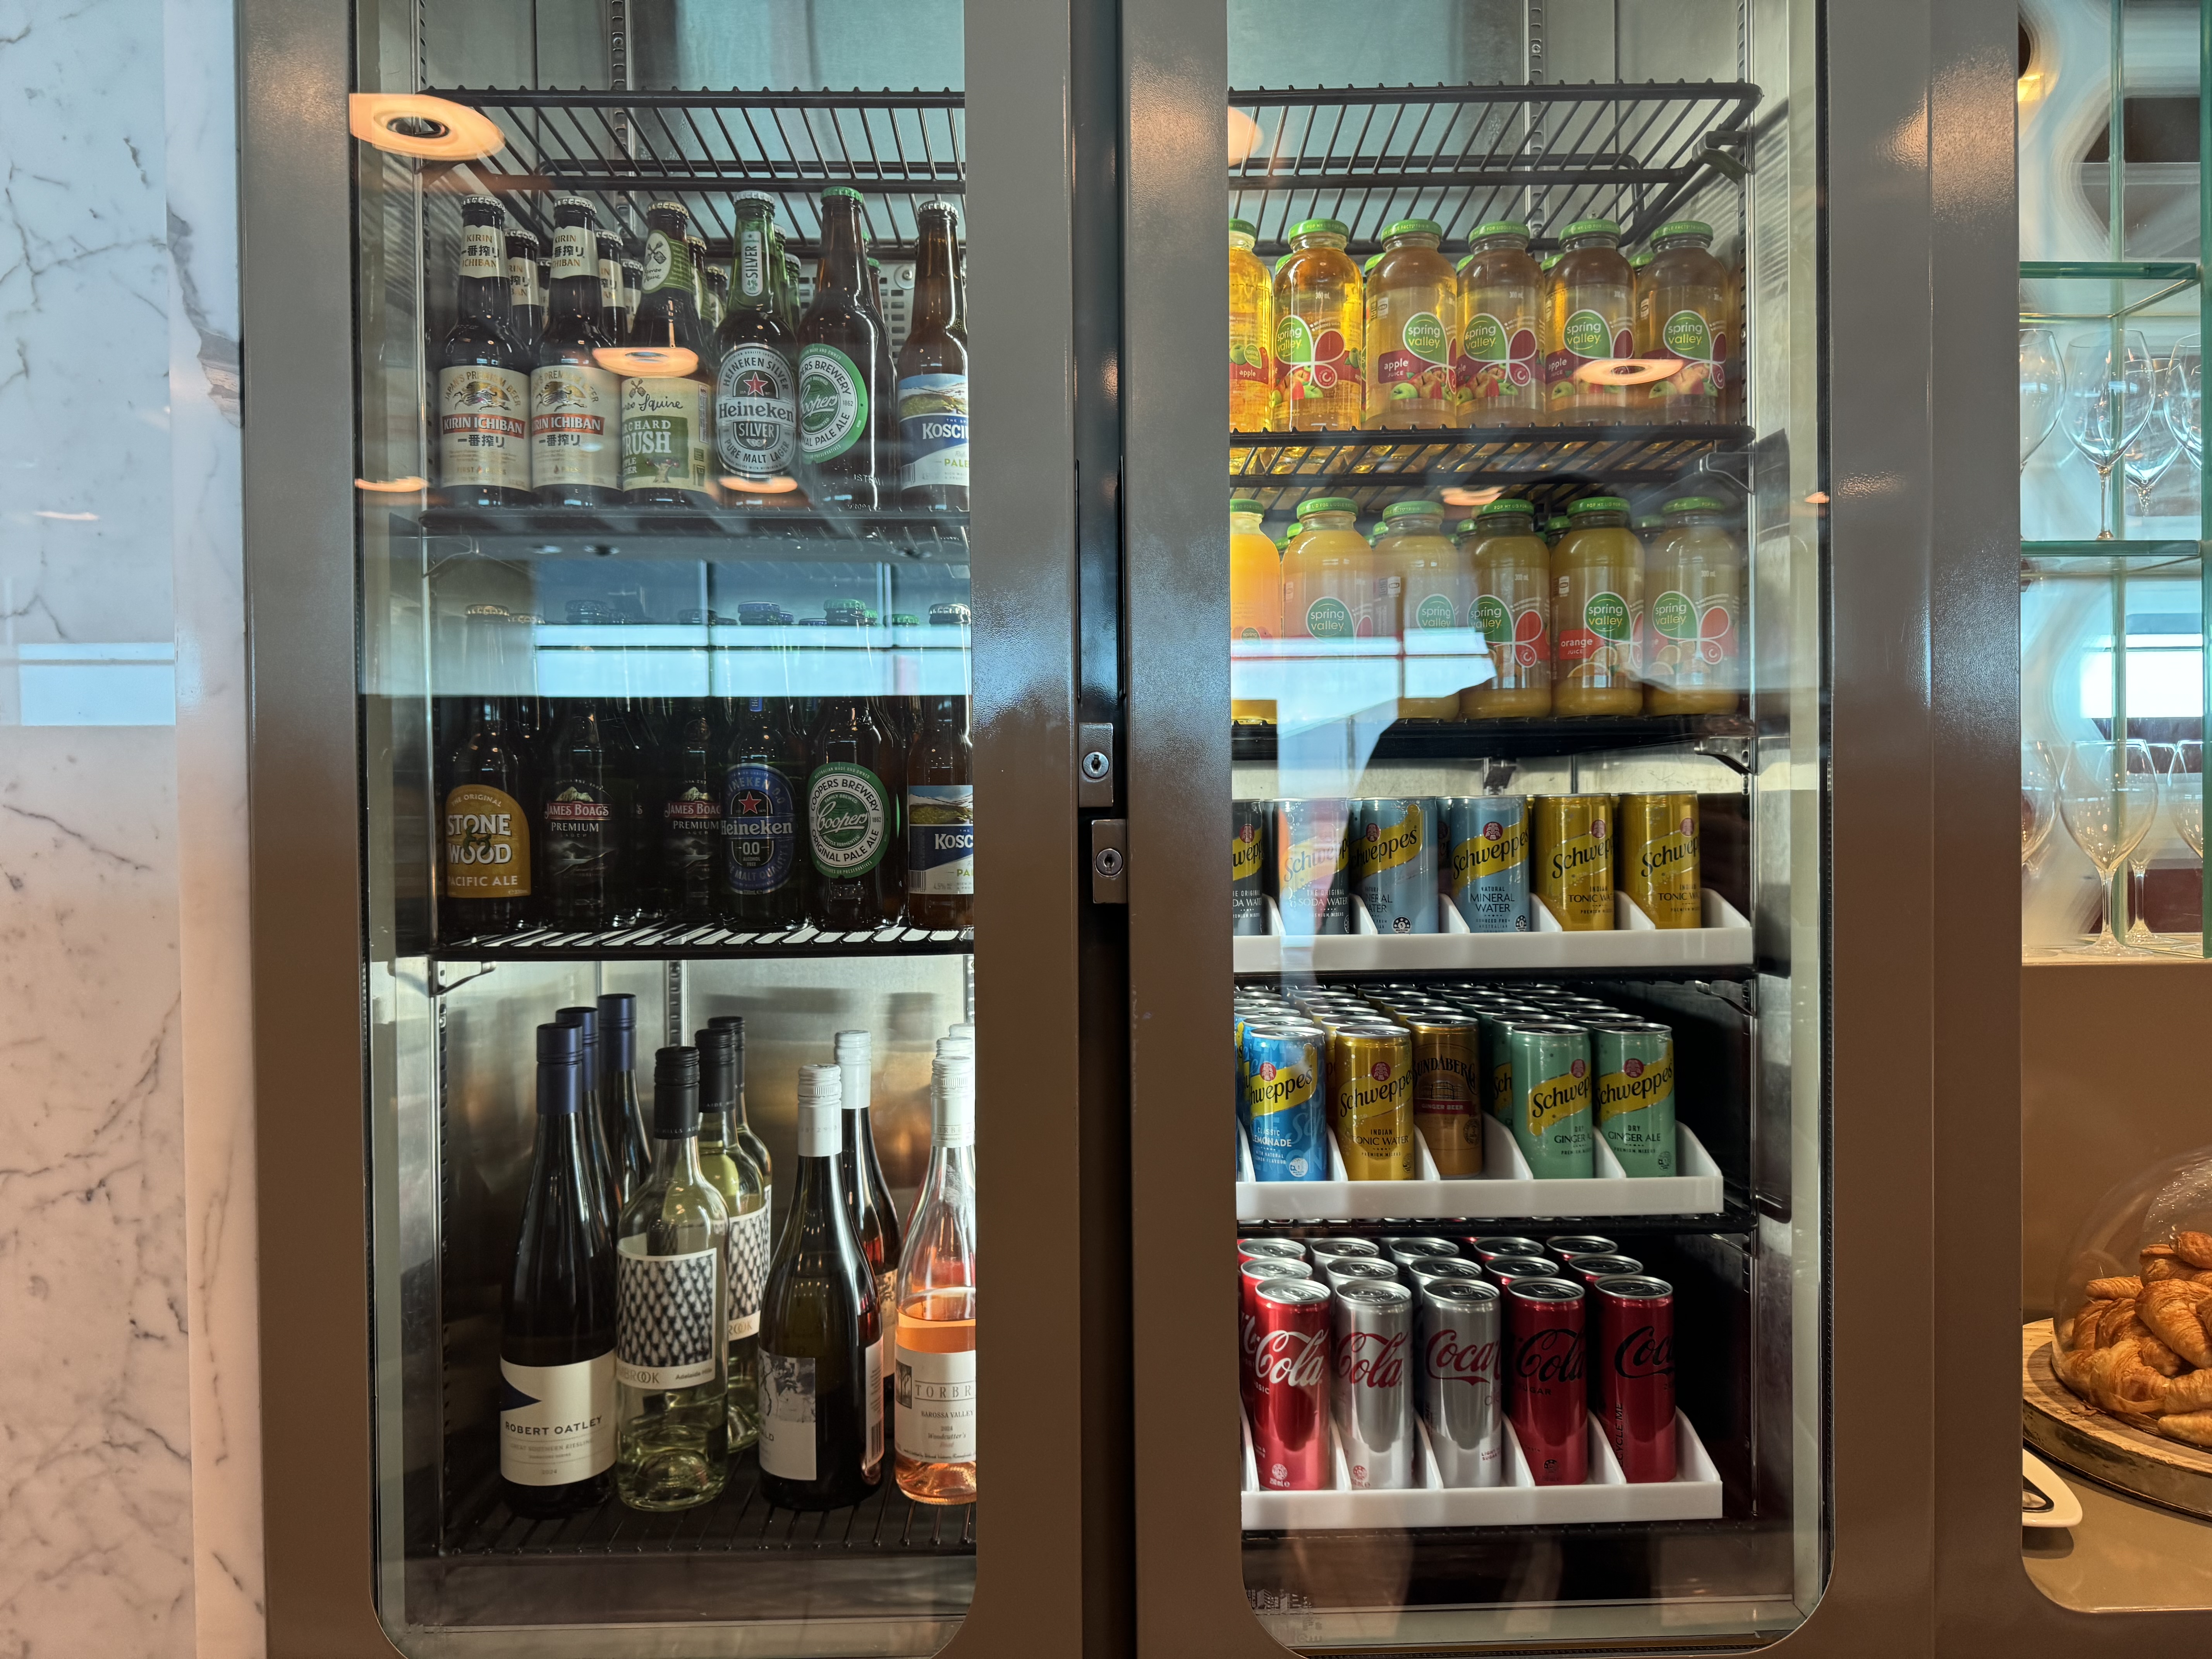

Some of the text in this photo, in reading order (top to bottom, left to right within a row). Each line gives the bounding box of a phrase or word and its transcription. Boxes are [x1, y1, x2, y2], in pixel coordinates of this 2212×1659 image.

[466, 234, 493, 244] KIRIN
[461, 246, 500, 258] 一番搾り
[554, 246, 585, 258] 番搾り
[462, 259, 496, 268] ICHIBAN
[745, 246, 757, 279] SILVER
[1277, 325, 1302, 343] spring
[1408, 325, 1440, 340] spring
[1465, 321, 1496, 340] spring
[1566, 321, 1601, 336] spring
[1668, 322, 1702, 335] spring
[1277, 338, 1302, 352] valley
[1408, 338, 1440, 347] valley
[1465, 336, 1496, 350] valley
[1567, 334, 1601, 345] valley
[1668, 334, 1702, 345] valley
[1384, 359, 1409, 371] apple
[723, 357, 789, 391] HEINEKEN SILVER
[814, 360, 852, 396] BREWERY
[1239, 369, 1256, 378] apple
[507, 383, 521, 407] BEER
[639, 394, 683, 412] Squire
[718, 401, 794, 423] Heineken
[443, 417, 522, 434] KIRIN ICHIBAN
[551, 417, 601, 431] ICHIBAN
[623, 420, 672, 430] RCHARD
[814, 428, 837, 446] PALE
[838, 412, 850, 433] ALE
[738, 424, 775, 438] SILVER
[457, 434, 505, 448] 一番搾り
[539, 434, 580, 447] 一番搾り
[724, 438, 741, 459] PURE
[743, 453, 767, 464] MALT
[770, 441, 790, 463] LAGER
[1310, 608, 1345, 621] spring
[1421, 608, 1451, 619] spring
[1470, 606, 1502, 619] spring
[1588, 604, 1623, 617] spring
[1655, 603, 1687, 615] spring
[1310, 620, 1345, 631] valley
[1421, 618, 1451, 628] valley
[1588, 616, 1623, 627] valley
[1655, 614, 1686, 626] valley
[1561, 637, 1593, 648] orange
[856, 770, 870, 779] OWNED
[464, 794, 501, 807] ORIGINAL
[811, 778, 880, 812] COOPERS BREWERY
[544, 804, 609, 819] JAMES BOAG'S
[664, 803, 694, 817] JAMES
[817, 801, 868, 833] Coopers
[448, 814, 512, 836] STONE
[551, 822, 599, 832] PREMIUM
[673, 821, 719, 830] PREMIUM
[721, 820, 793, 835] Heineken
[742, 842, 760, 855] 0.0
[812, 829, 879, 862] ORIGINAL PALE ALE
[1354, 829, 1417, 867] hweppes
[449, 843, 512, 864] WOOD
[1284, 836, 1348, 882] Schwepp
[1453, 828, 1529, 879] Schweppes
[1552, 836, 1613, 879] Schwep
[1641, 836, 1698, 878] Schwep
[492, 876, 518, 885] ALE
[735, 870, 756, 881] MALT
[1298, 898, 1325, 906] SODA
[1471, 893, 1515, 902] MINERAL
[1568, 893, 1597, 902] TONIC
[1658, 892, 1688, 901] TONIC
[1475, 904, 1510, 912] WATER
[1413, 1054, 1477, 1095] BUNDABERG
[1249, 1069, 1312, 1104] hweppes
[1340, 1066, 1413, 1118] Schweppes
[1596, 1063, 1672, 1111] Schweppes
[1532, 1077, 1591, 1118] Schwep
[1258, 1127, 1280, 1136] CLASSIC
[1608, 1132, 1661, 1142] GINGER ALE
[1252, 1136, 1292, 1147] LEMONADE
[1353, 1136, 1408, 1145] TONIC WATER
[1554, 1135, 1585, 1144] GINGER
[625, 1370, 659, 1384] BROOK
[675, 1370, 701, 1381] Adelaide
[921, 1410, 974, 1419] BAROSSA VALLEY
[505, 1415, 602, 1436] ROBERT OATLEY
[1616, 1403, 1624, 1468] ECYCLE ME
